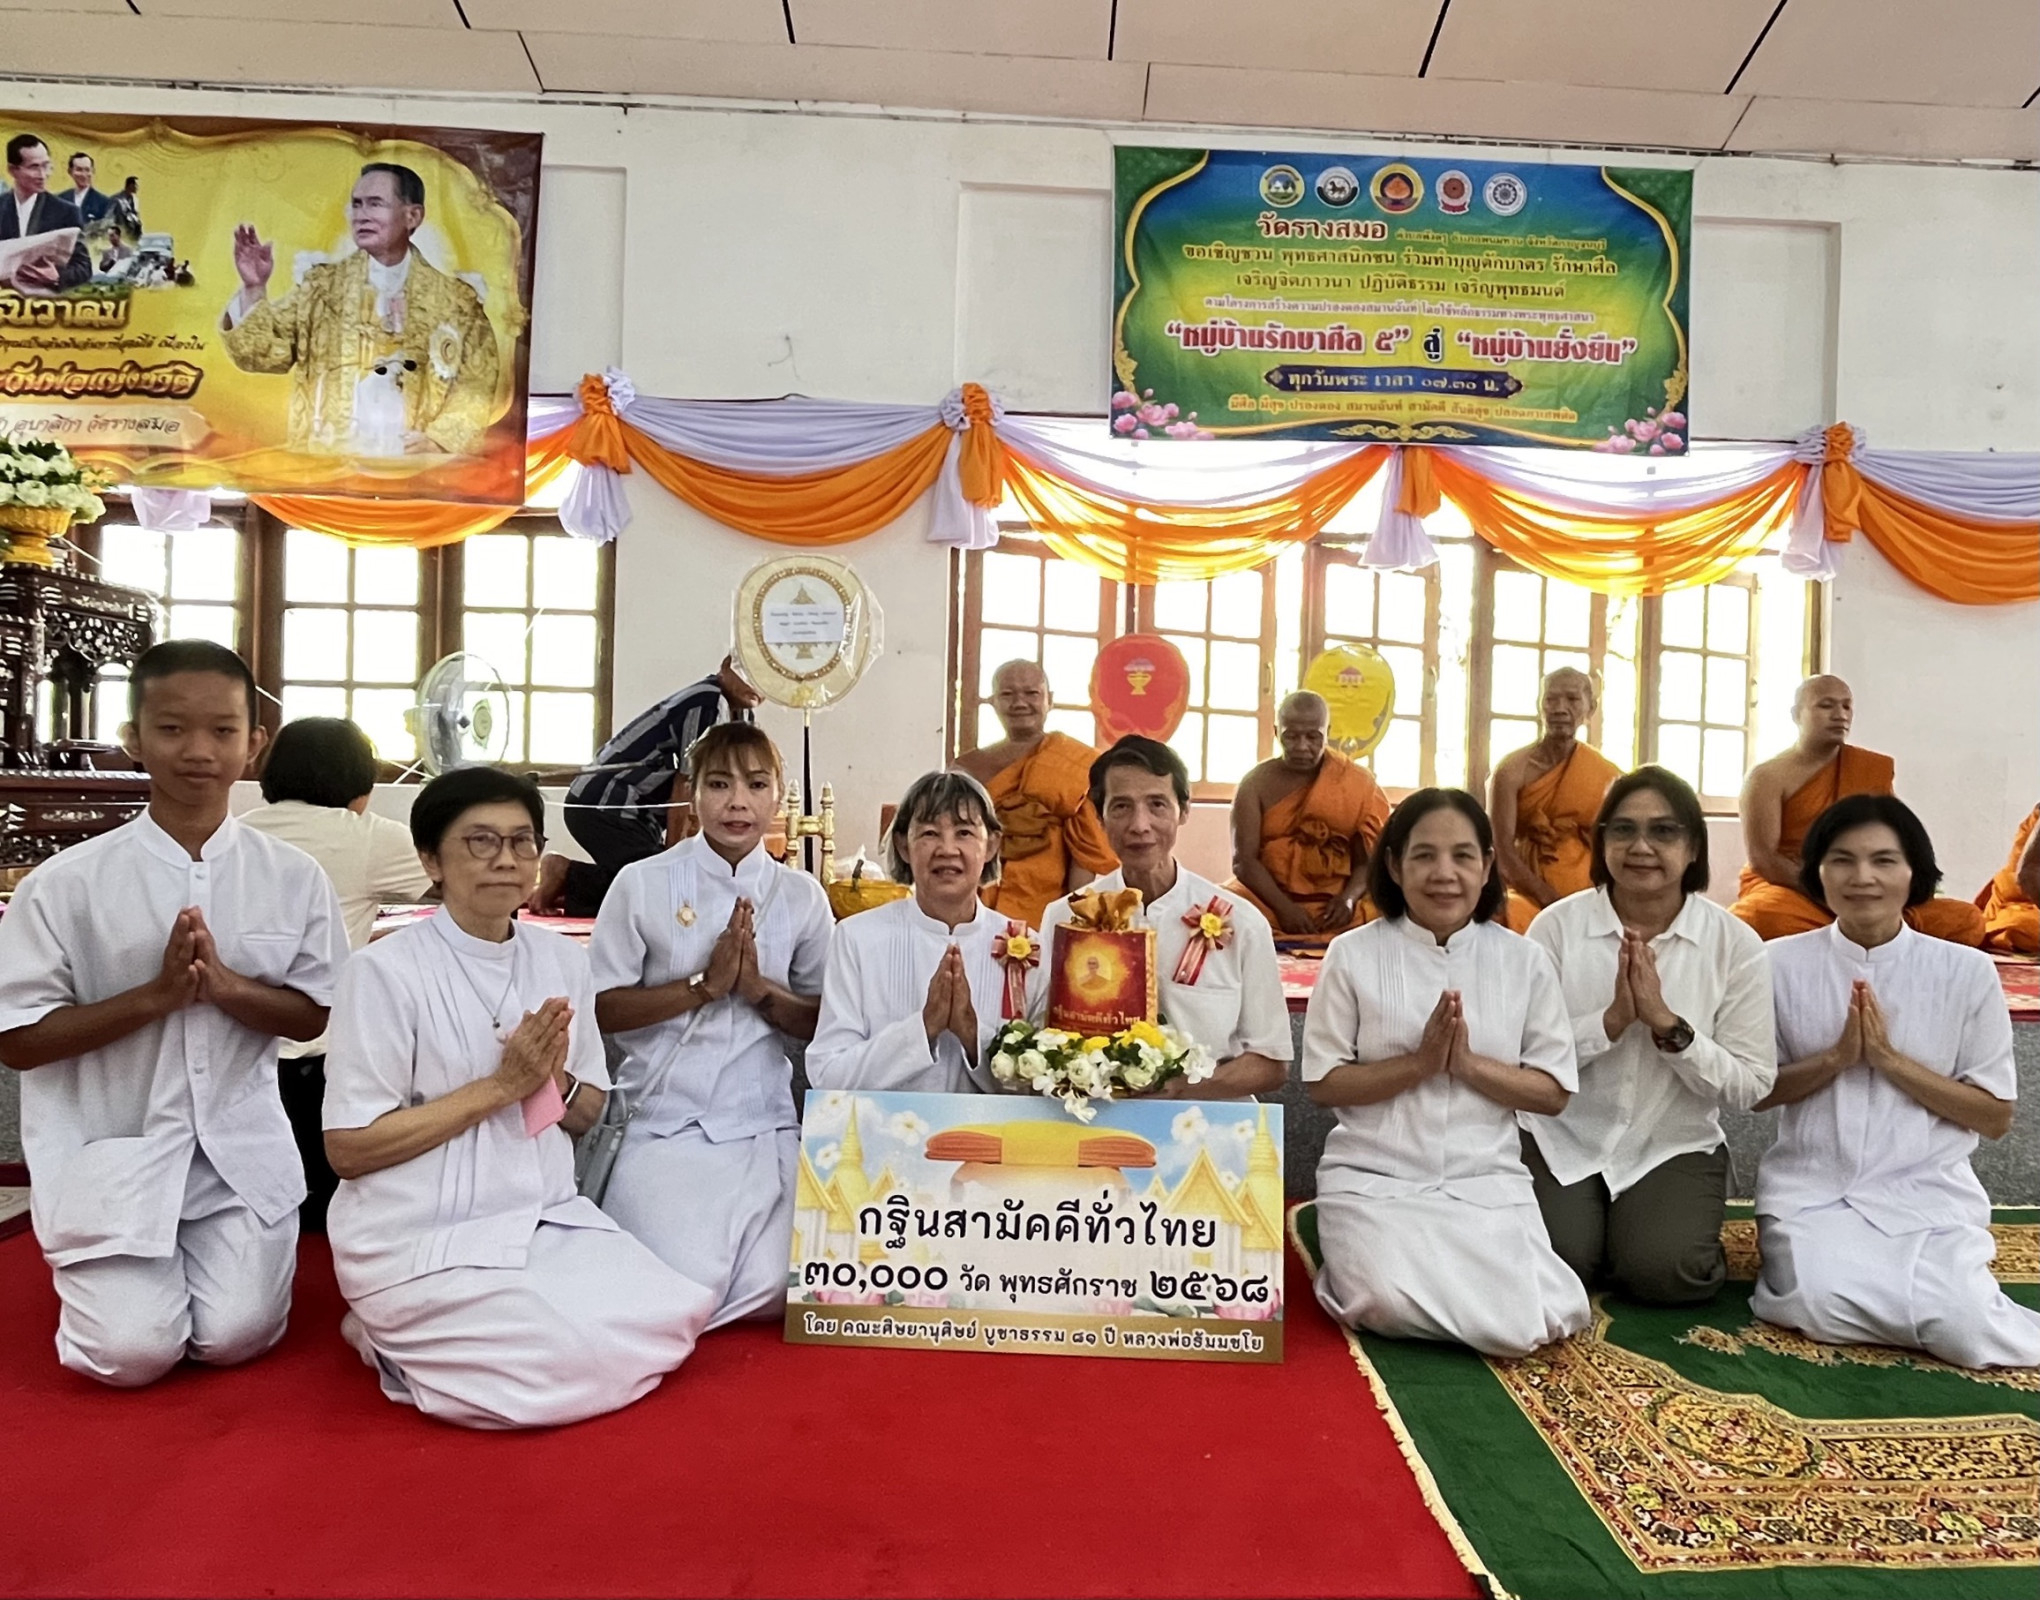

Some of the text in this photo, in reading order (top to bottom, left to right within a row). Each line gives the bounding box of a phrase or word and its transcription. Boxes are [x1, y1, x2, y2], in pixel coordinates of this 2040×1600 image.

[1258, 212, 1387, 240] วัดรางสมอ
[1184, 241, 1616, 275] ขอเชิญชวน พุทธศาสนิกชน ร่วมทำบุญตักบาตร รักษาศีล
[1237, 270, 1565, 299] เจริญจิตภาวนา ปฏิบัติธรรม เจริญพุทธมนต์
[1423, 328, 1441, 360] สู่
[1457, 328, 1637, 364] “หมู่บ้านยั่งยืน”
[1288, 370, 1500, 392] ทุกวันพระ เวลา ๐๗.๓๐ น.
[87, 414, 181, 434] วัดรางสมอ
[859, 1190, 1217, 1249] กฐินสามัคคีทั่วไทย
[804, 1261, 1269, 1303] ๓๐,๐๐๐ วัด พุทธศักราช ๒๕๖๘
[805, 1314, 1263, 1352] โดย คณะศิษยานุศิษย์ บูชาธรรม ๘๑ ปี หลวงพ่อธัมมชโย
